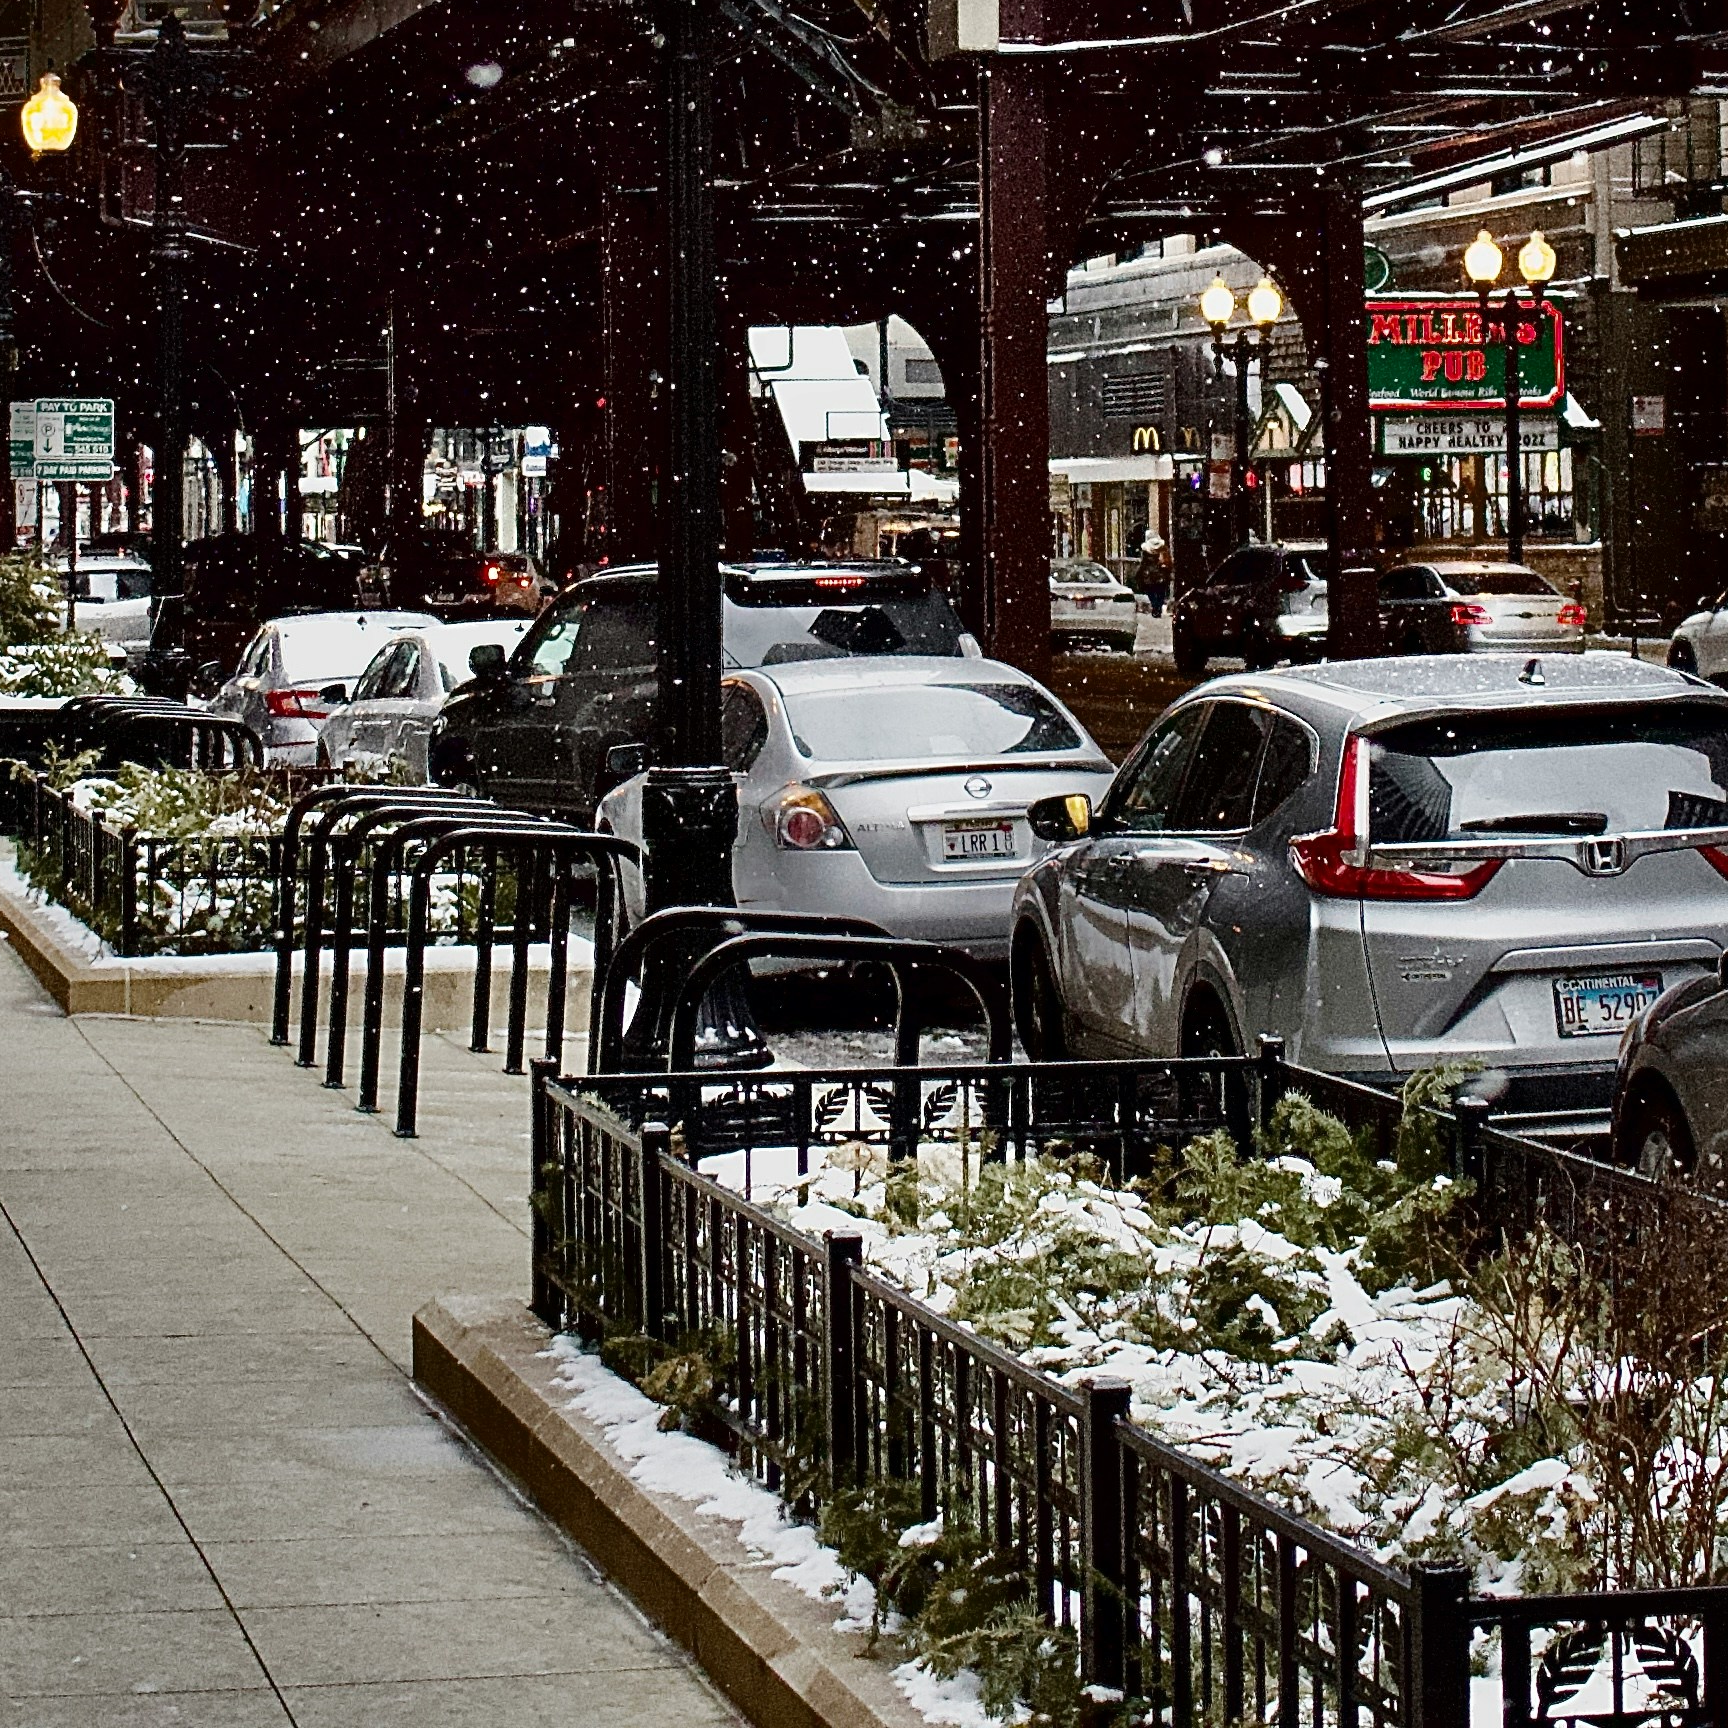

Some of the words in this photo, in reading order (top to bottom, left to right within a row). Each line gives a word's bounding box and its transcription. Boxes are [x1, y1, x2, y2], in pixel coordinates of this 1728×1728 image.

[1420, 350, 1486, 383] PUB
[1410, 387, 1438, 399] World
[40, 402, 61, 412] PAY
[62, 402, 78, 412] TO
[79, 402, 108, 413] PARK
[1416, 423, 1464, 435] CHEERS
[1475, 422, 1491, 434] TO
[1398, 437, 1440, 449] HAPPY
[1447, 435, 1504, 449] HEALTHY
[856, 820, 906, 833] ALTA
[961, 833, 988, 853] LRR
[992, 832, 1000, 851] 1
[1557, 975, 1638, 992] CONTINENTAL
[1562, 993, 1590, 1025] BE
